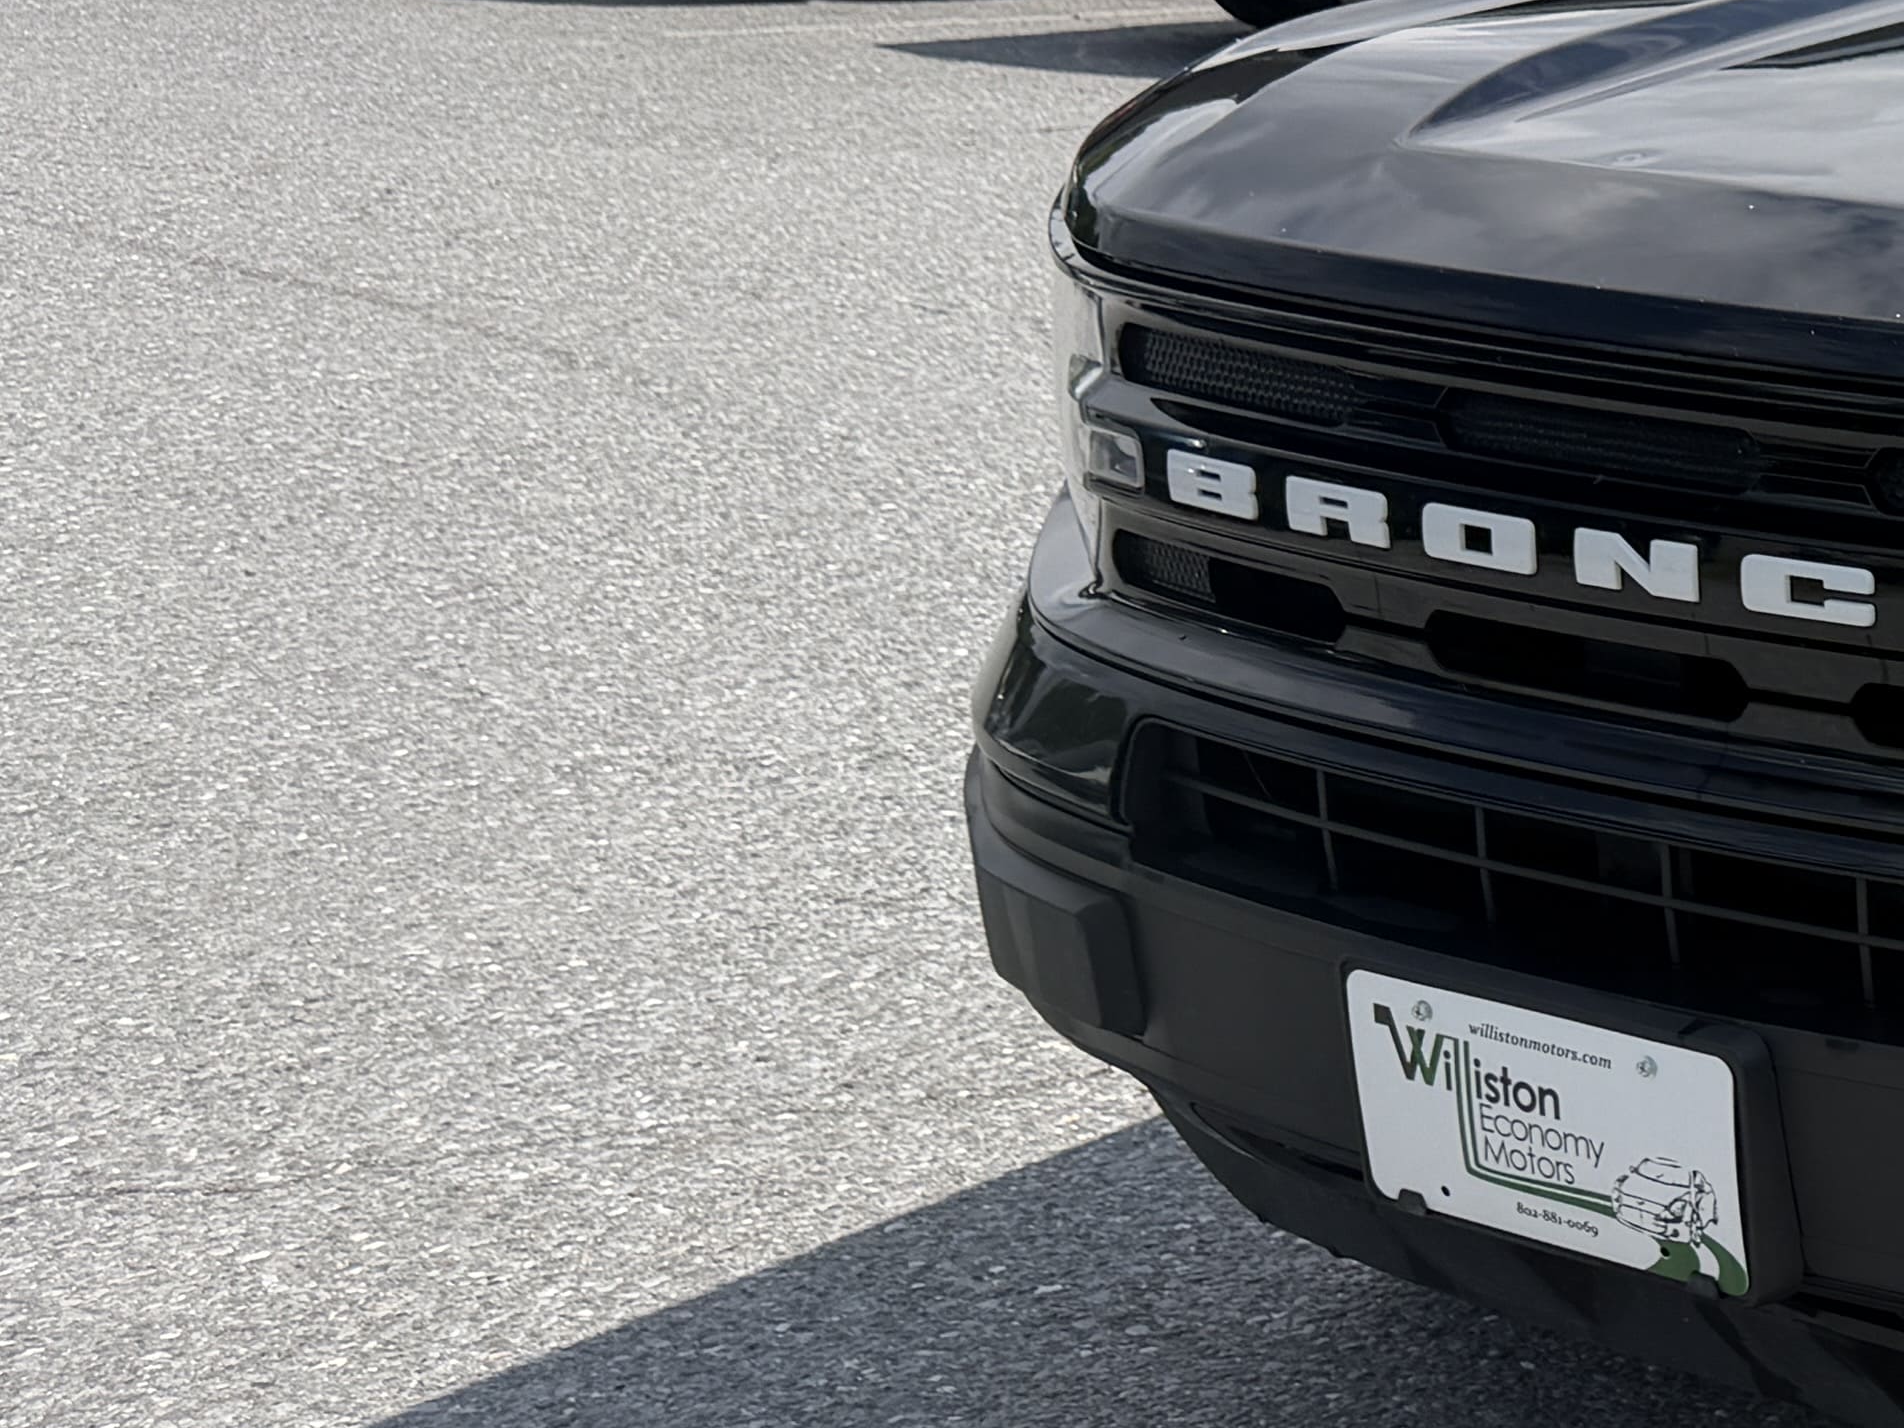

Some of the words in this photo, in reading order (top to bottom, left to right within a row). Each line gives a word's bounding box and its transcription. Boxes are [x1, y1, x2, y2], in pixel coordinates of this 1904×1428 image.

[1468, 1022, 1612, 1070] willistonmotors.com
[1479, 1103, 1605, 1169] Economy
[1483, 1136, 1576, 1185] Motors
[1516, 1201, 1599, 1238] 802-881-0069
